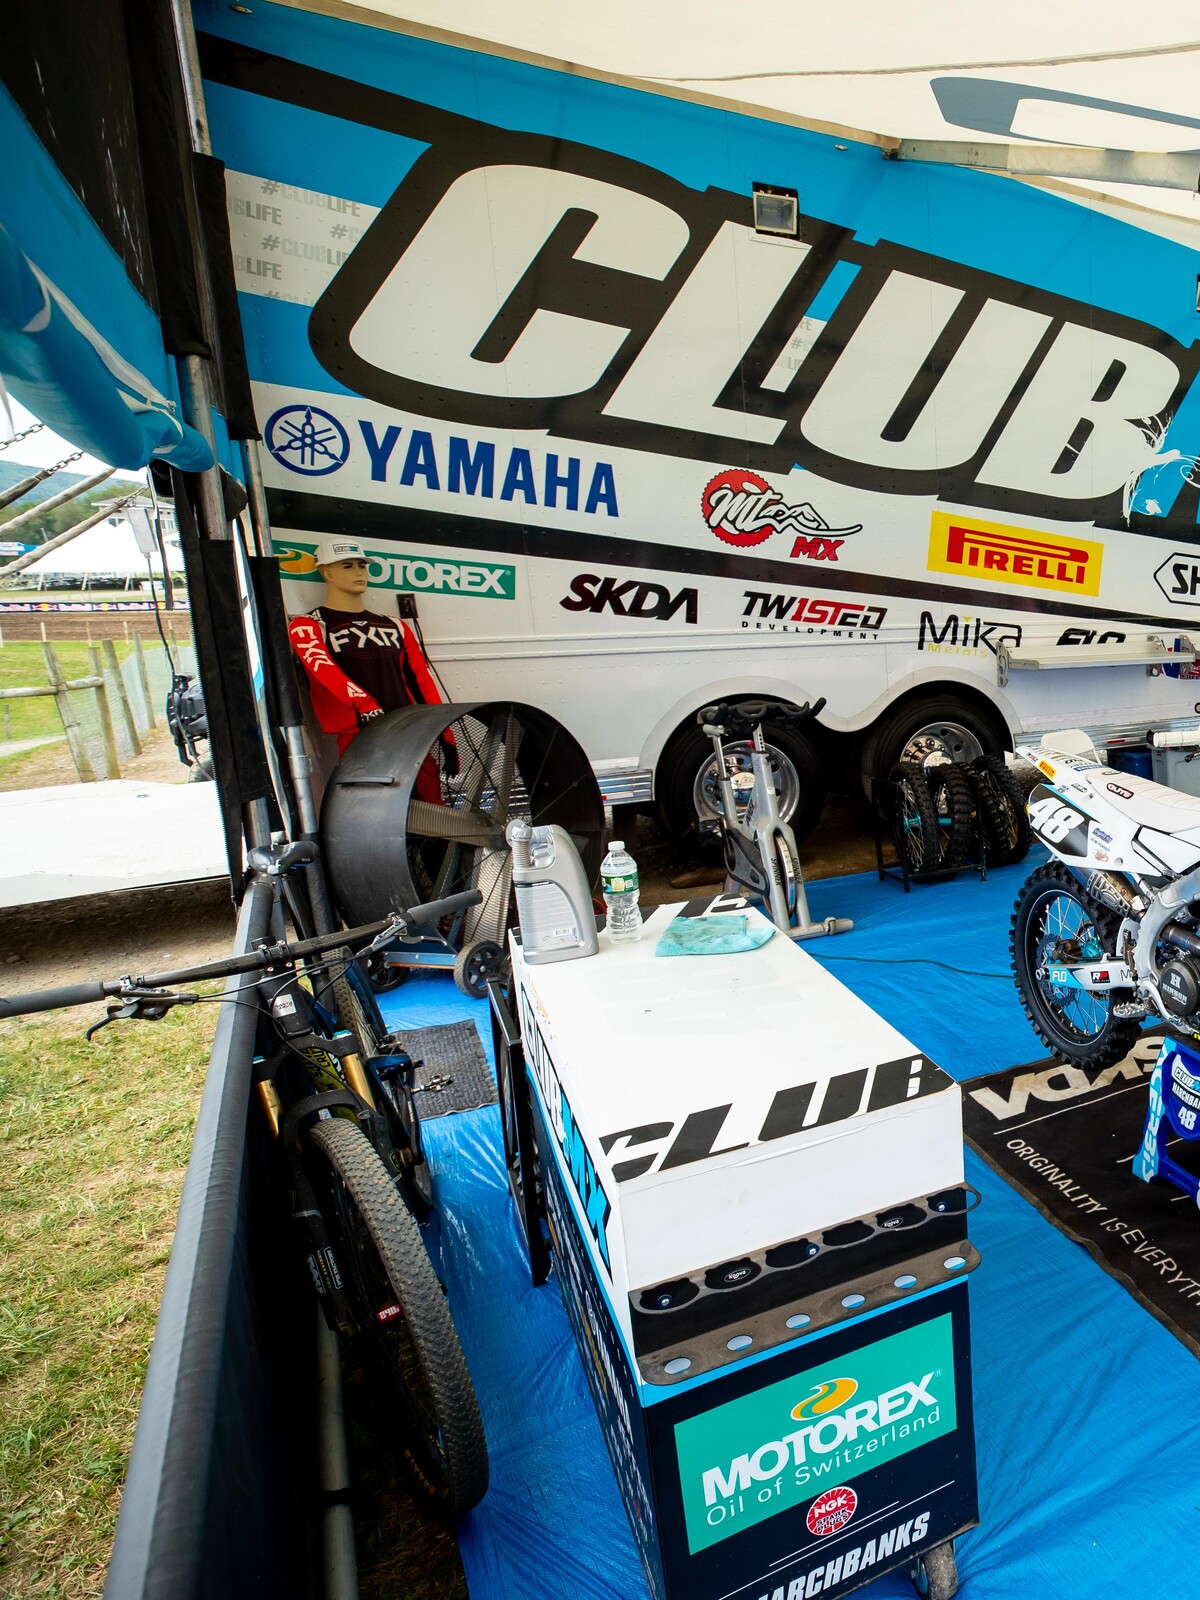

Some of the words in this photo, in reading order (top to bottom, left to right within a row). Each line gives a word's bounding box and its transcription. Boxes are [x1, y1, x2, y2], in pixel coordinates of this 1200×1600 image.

[261, 235, 350, 266] #CLUBLI
[234, 254, 282, 280] BLIFE
[358, 420, 619, 517] YAMAHA
[790, 536, 845, 562] MX
[946, 526, 1089, 584] PIRELLI
[366, 556, 507, 595] OTOREX
[559, 573, 698, 624] SKDA
[329, 626, 400, 653] FXR
[742, 620, 879, 641] DEVELOPMENT
[918, 611, 1022, 655] Mika
[1108, 784, 1132, 797] GUTS
[1028, 797, 1085, 843] 48
[771, 857, 781, 886] SPINNER
[1052, 971, 1067, 982] FLO
[1092, 971, 1109, 980] RP
[1178, 1106, 1197, 1130] 48
[1006, 1138, 1108, 1214] ORIGINALITY
[1100, 1217, 1127, 1232] IS
[701, 1371, 934, 1507] MOTOREX
[707, 1499, 745, 1526] Oil
[757, 1479, 783, 1507] of
[795, 1406, 941, 1486] Switzerland
[812, 1493, 848, 1518] NGK
[816, 1507, 848, 1529] SPARK
[816, 1515, 849, 1537] PLUGS
